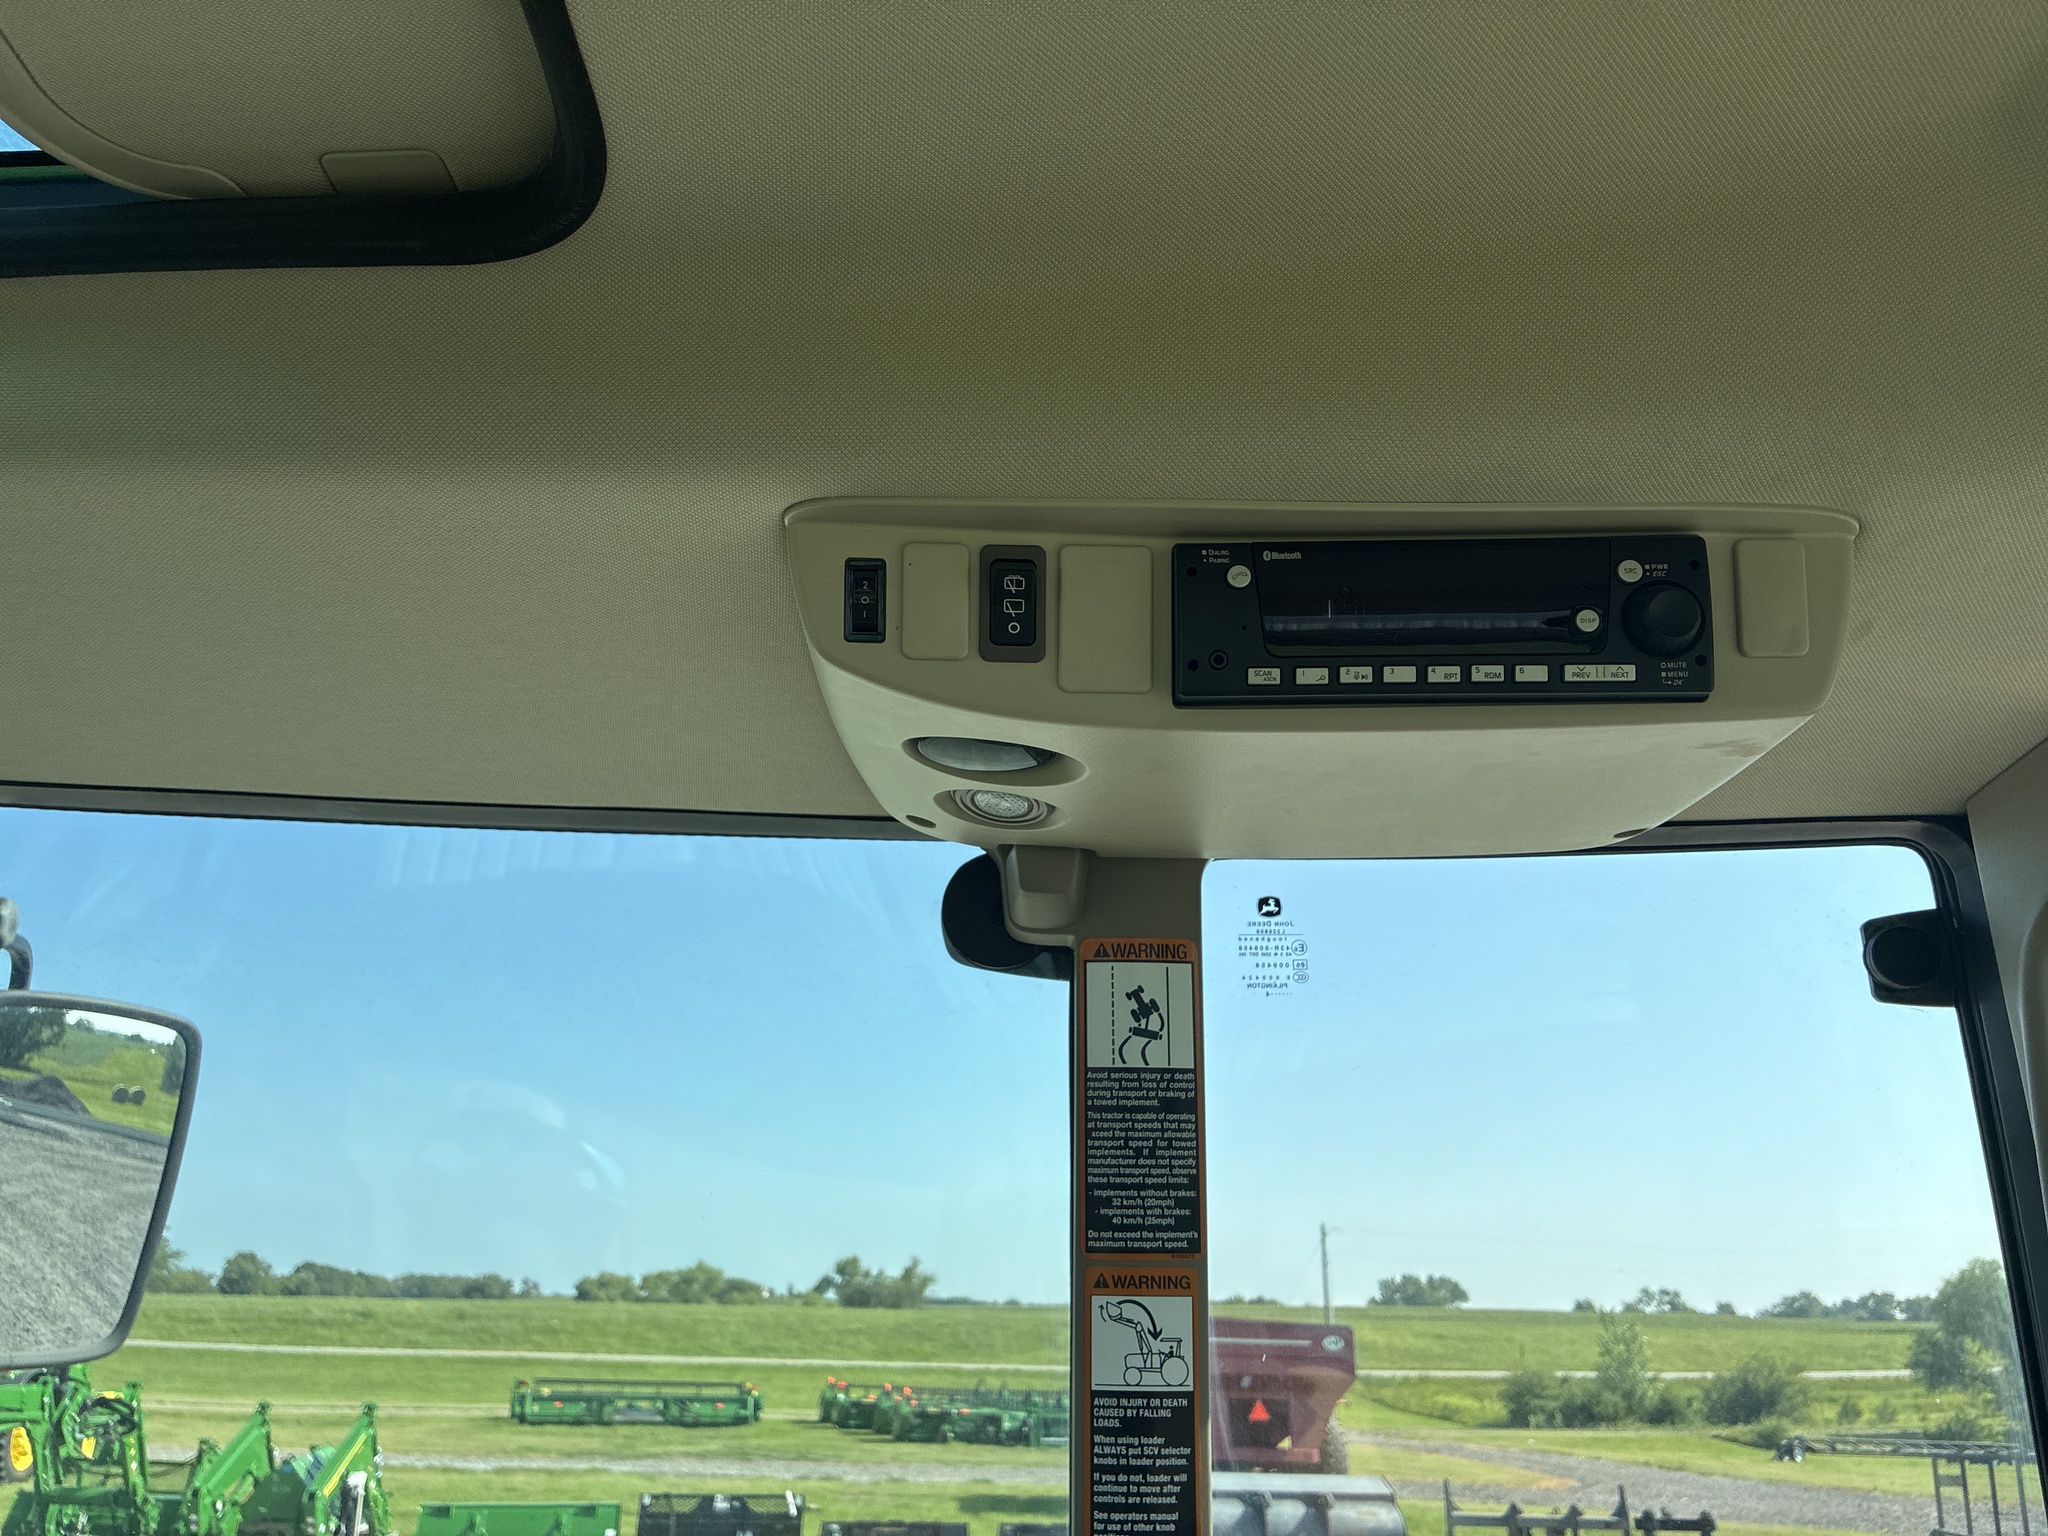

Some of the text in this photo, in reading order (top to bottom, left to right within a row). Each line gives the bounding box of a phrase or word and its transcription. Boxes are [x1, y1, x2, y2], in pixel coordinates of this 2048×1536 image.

[863, 581, 868, 589] 2
[1111, 943, 1187, 960] WARNING
[1140, 1072, 1160, 1080] injury
[1087, 1081, 1119, 1089] resulting
[1087, 1090, 1111, 1098] during
[1112, 1090, 1147, 1098] transport
[1158, 1090, 1185, 1099] braking
[1119, 1099, 1160, 1107] implement.
[1132, 1112, 1157, 1120] capable
[1166, 1113, 1195, 1121] operating
[1171, 1158, 1196, 1166] specify
[1145, 1176, 1167, 1184] speed
[1094, 1189, 1138, 1197] implements
[1144, 1198, 1174, 1207] (20mph)
[1100, 1208, 1144, 1216] implements
[1144, 1217, 1175, 1226] (25mph)
[1155, 1231, 1198, 1239] implement's
[1164, 1240, 1189, 1248] speed.
[1112, 1275, 1191, 1289] WARNING
[1094, 1398, 1117, 1406] AVOID
[1120, 1398, 1148, 1406] INJURY
[1162, 1398, 1188, 1407] DEATH
[1094, 1408, 1124, 1416] CAUSED
[1139, 1409, 1172, 1417] FALLING
[1094, 1419, 1122, 1427] LOADS.
[1094, 1435, 1165, 1445] When using loader
[1094, 1446, 1126, 1454] ALWAYS
[1128, 1447, 1141, 1456] put
[1143, 1446, 1159, 1454] SCV
[1094, 1456, 1117, 1465] knobs
[1129, 1457, 1153, 1465] loader
[1155, 1457, 1189, 1467] position.
[1094, 1473, 1188, 1483] If you do not, loader will
[1162, 1484, 1181, 1492] after
[1143, 1495, 1178, 1504] released.
[1094, 1511, 1178, 1521] See operators manual
[1094, 1522, 1105, 1530] for
[1123, 1523, 1131, 1531] of
[1133, 1523, 1154, 1531] other
[1156, 1523, 1175, 1531] knob
